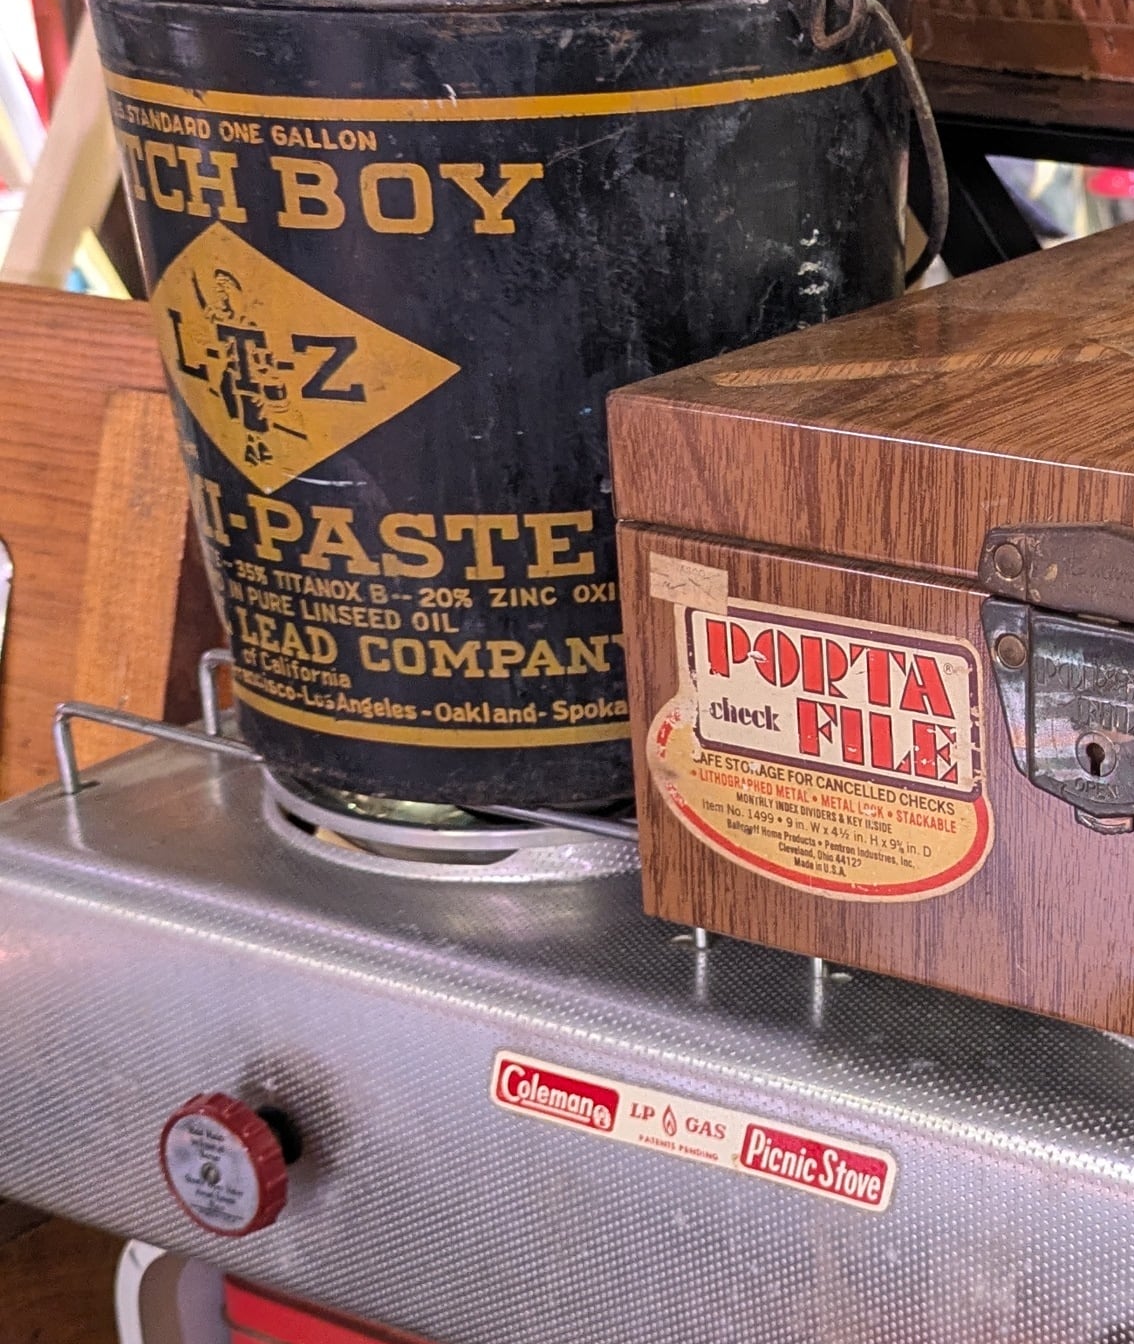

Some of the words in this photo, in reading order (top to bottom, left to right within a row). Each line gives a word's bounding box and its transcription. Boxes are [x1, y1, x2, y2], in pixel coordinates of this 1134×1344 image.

[127, 104, 211, 141] STANDARD
[219, 121, 264, 145] ONE
[272, 124, 377, 152] GALLON
[272, 156, 544, 235] BOY
[247, 588, 296, 617] PURE
[301, 600, 401, 632] LINSEED
[412, 612, 460, 634] OIL
[274, 570, 362, 604] TITANOX
[489, 585, 558, 609] ZINC
[235, 607, 340, 666] LEAD
[242, 647, 257, 665] of
[259, 651, 352, 690] California
[705, 619, 956, 720] PORTA
[709, 697, 782, 733] check
[796, 697, 960, 785] FILE
[699, 769, 774, 797] LITHOGRAPHED
[776, 785, 810, 804] METAL
[820, 795, 856, 814] METAL
[896, 810, 958, 834] STACKABLE
[736, 792, 774, 810] MONTHLY
[775, 801, 799, 815] INDEX
[800, 805, 837, 822] DIVIDERS
[846, 816, 863, 828] KEY
[788, 771, 814, 787] FOR
[816, 776, 897, 804] CANCELLED
[899, 793, 956, 816] CHECKS
[702, 798, 724, 814] Item
[727, 804, 745, 818] No.
[748, 809, 775, 824] 1499
[810, 822, 821, 835] W
[870, 834, 879, 845] H
[923, 845, 932, 858] D
[761, 826, 782, 840] Home
[784, 831, 816, 846] Products
[824, 839, 856, 856] Pentron
[794, 856, 814, 870] Made
[501, 1064, 595, 1117] Coleman
[629, 1102, 656, 1122] LP
[685, 1117, 728, 1140] GAS
[746, 1129, 817, 1182] Picnic
[817, 1149, 883, 1202] Stove
[638, 1134, 676, 1150] PATENTS
[679, 1144, 719, 1161] PENDING
